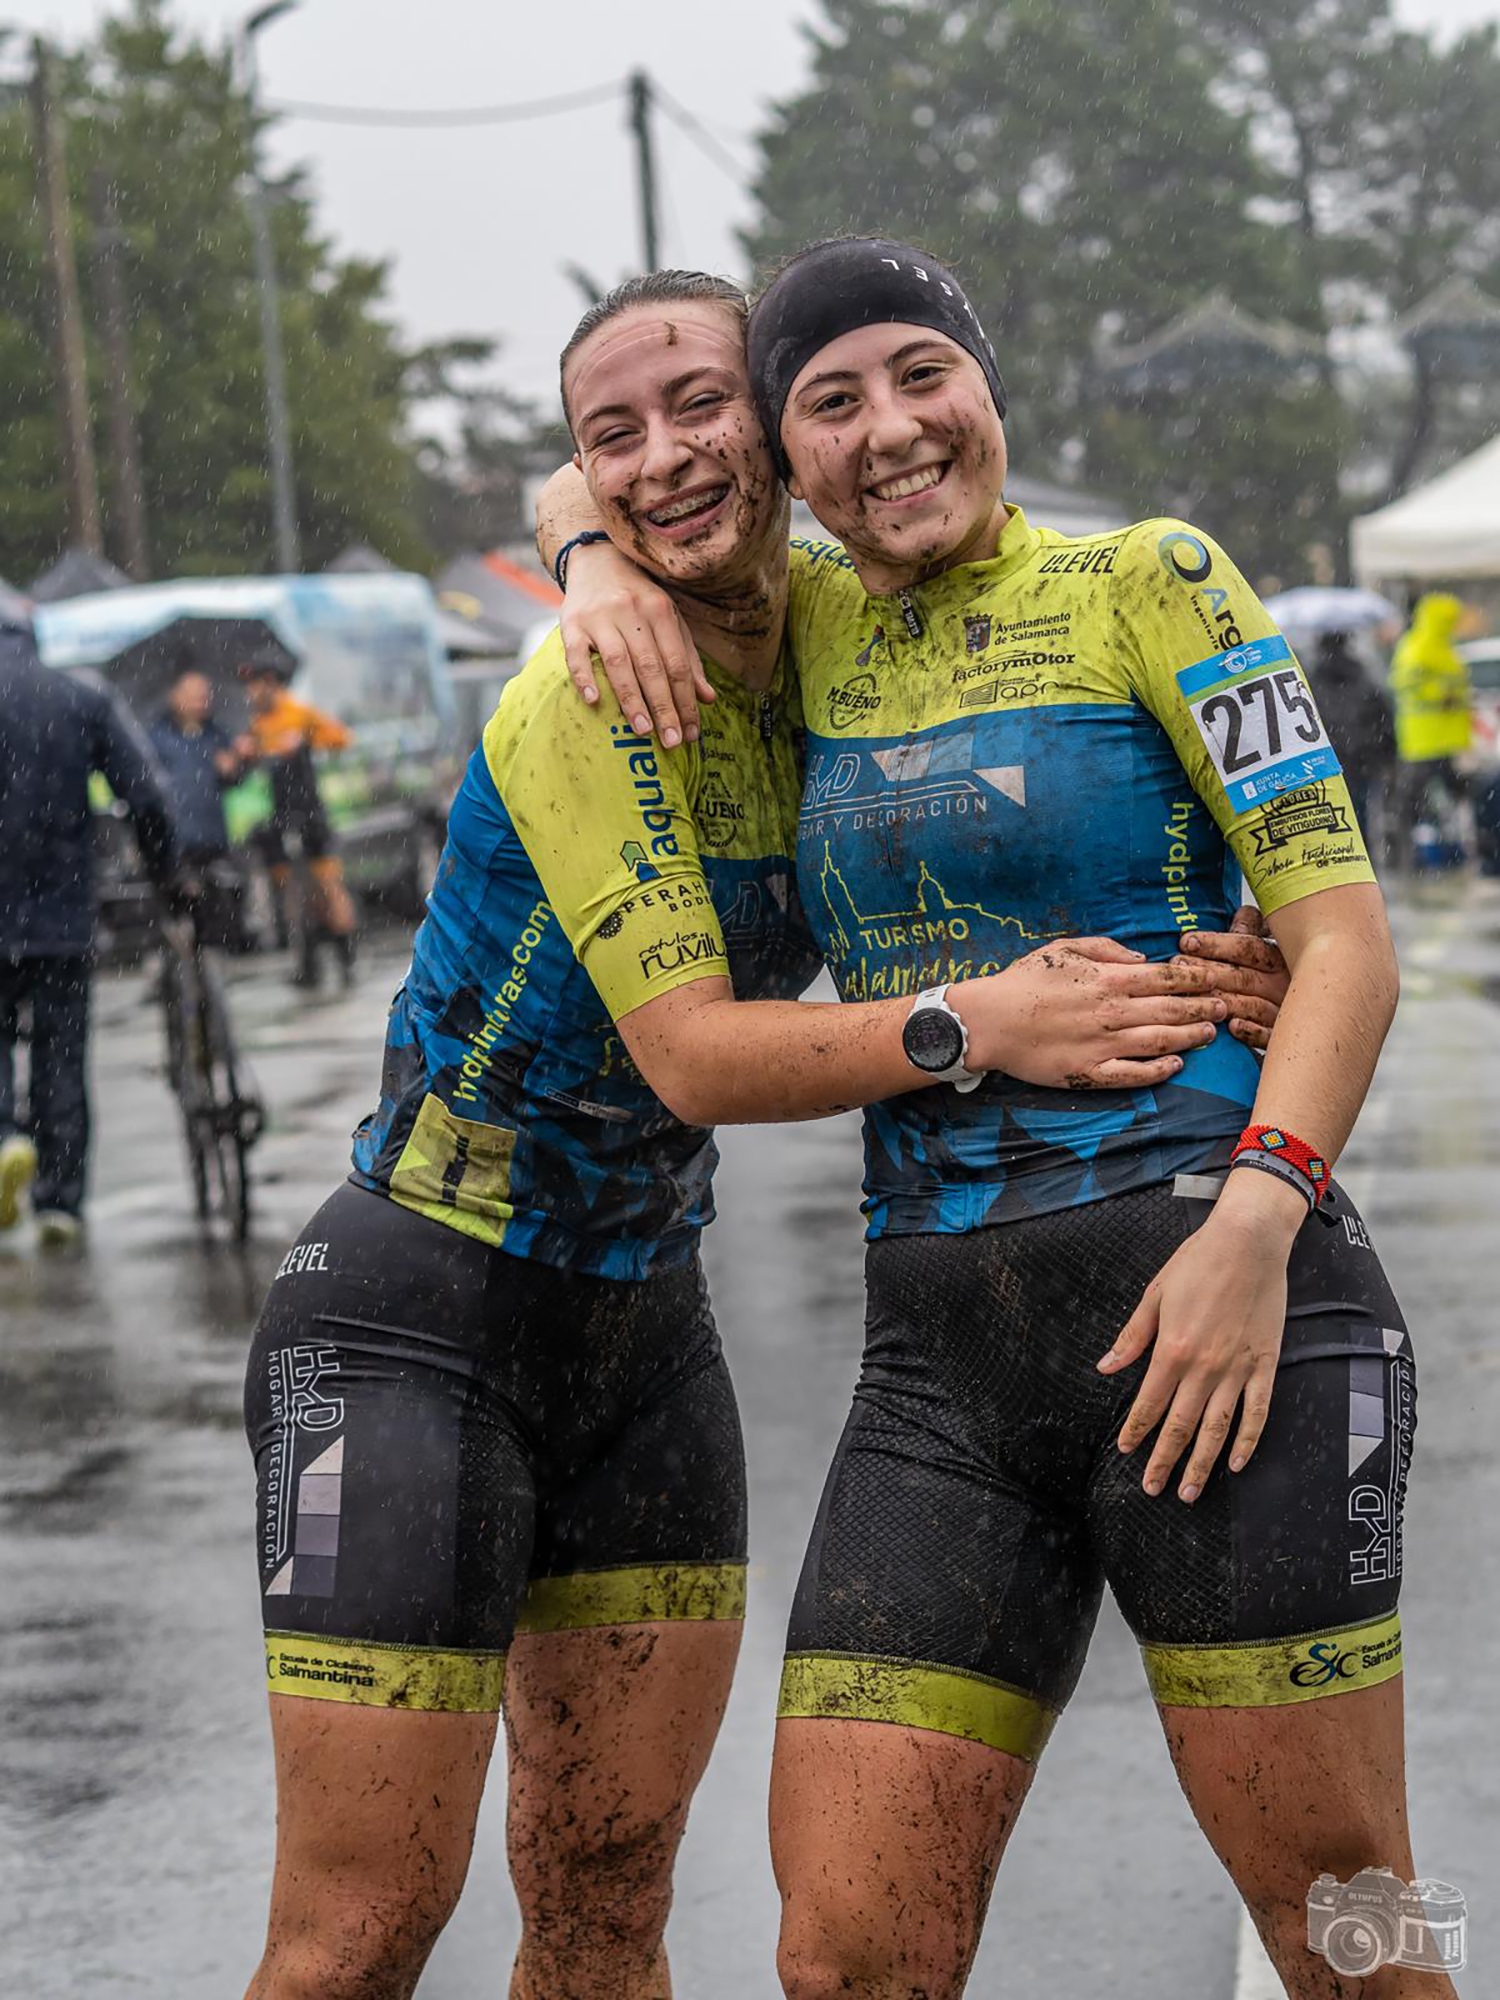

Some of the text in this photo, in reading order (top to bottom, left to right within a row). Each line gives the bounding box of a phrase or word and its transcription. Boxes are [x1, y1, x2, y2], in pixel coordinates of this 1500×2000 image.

[996, 612, 1071, 635] Ayuntamiento
[994, 626, 1070, 646] de Salamanca
[1200, 670, 1321, 775] 275
[610, 724, 679, 857] aquali
[1255, 772, 1281, 786] XUNTA
[1257, 773, 1297, 794] DE GALICIA
[833, 815, 844, 832] Y
[1269, 806, 1332, 828] EMBUTIDOS FLORES
[1271, 813, 1335, 839] DE VITIGUDINO
[1315, 857, 1329, 868] de
[859, 917, 970, 951] TURISMO
[640, 931, 728, 980] ruvilu
[264, 1350, 284, 1569] HOGAR Y DECORACIÓN
[279, 1652, 375, 1673] Escuela de Ciclismo
[279, 1662, 375, 1688] Salmantina
